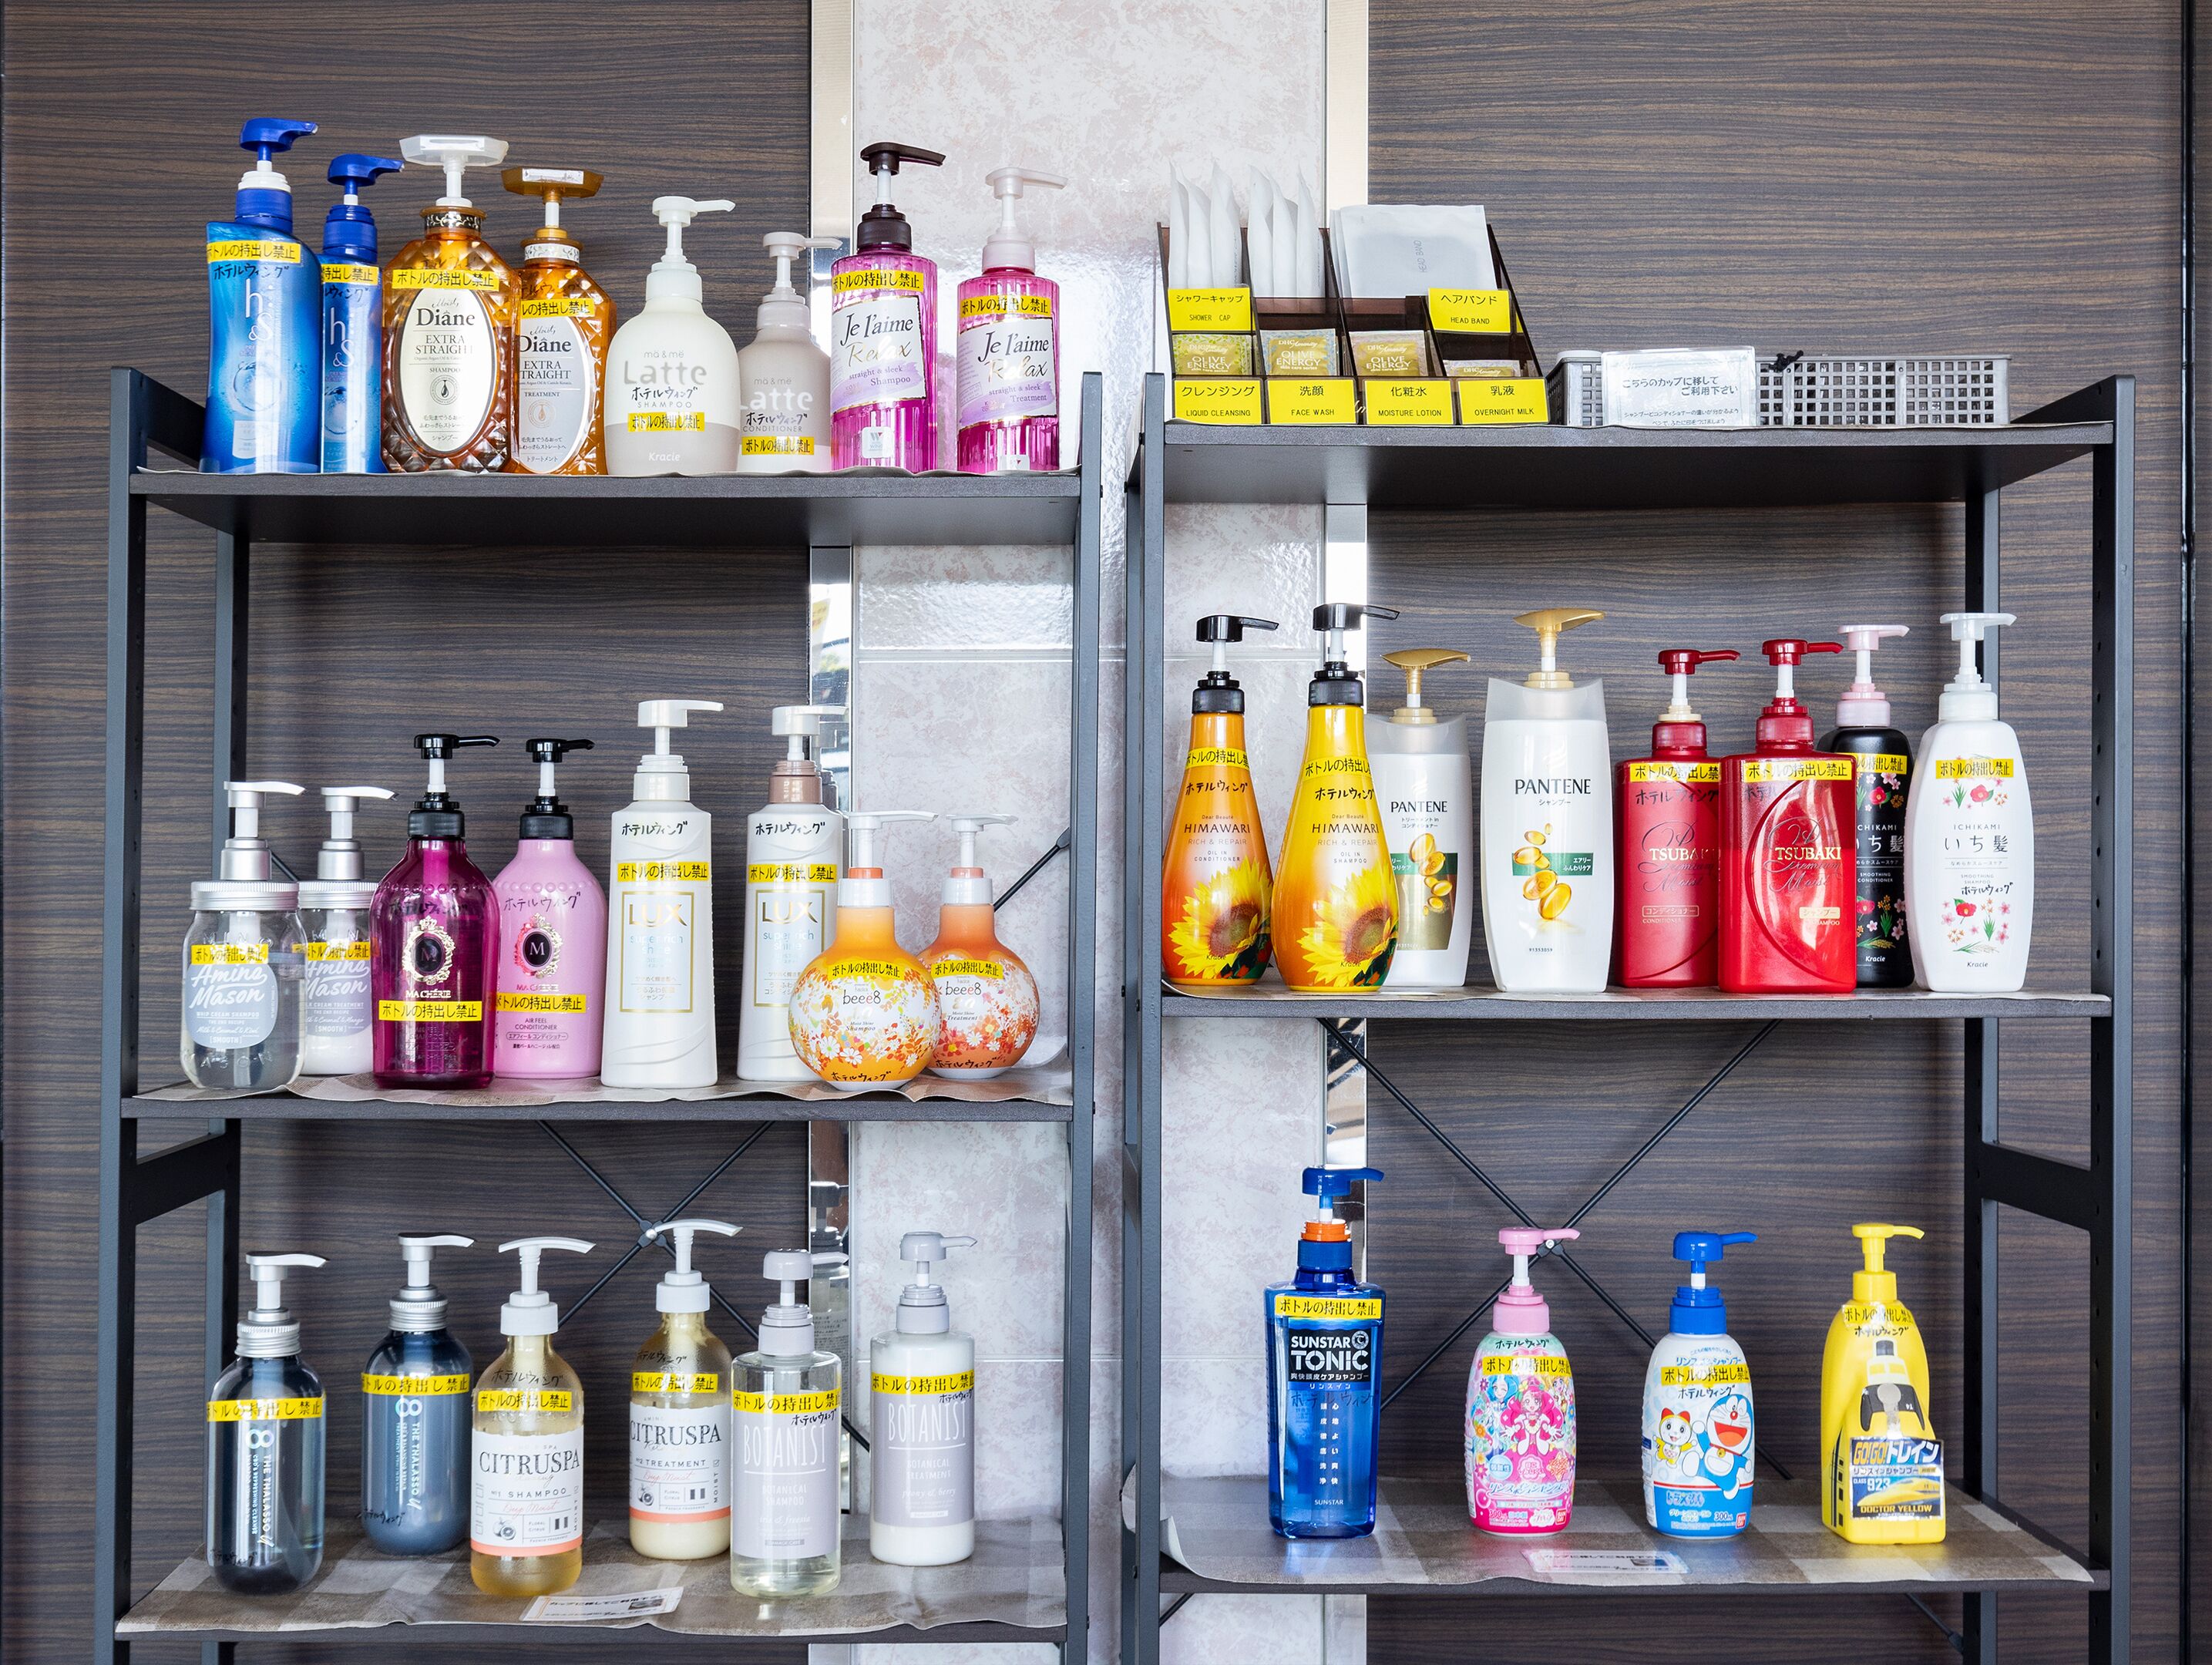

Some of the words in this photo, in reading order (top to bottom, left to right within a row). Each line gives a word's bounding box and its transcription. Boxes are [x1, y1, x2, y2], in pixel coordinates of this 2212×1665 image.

[397, 272, 495, 288] ボトルの持出し禁止
[833, 273, 920, 292] ボトルの持出し禁止
[962, 297, 1049, 314] ボトルの持出し禁止
[1176, 294, 1244, 304] シャワーキャップ
[1440, 294, 1498, 306] ヘアバンド
[840, 312, 861, 347] Je
[425, 335, 465, 344] EXTRA
[977, 331, 1001, 363] Je
[1280, 351, 1316, 359] OLIVE
[524, 361, 562, 369] EXTRA
[624, 360, 708, 385] Latte
[520, 370, 572, 379] TRAIGHT
[870, 375, 912, 386] Shampoo
[1622, 375, 1720, 388] こちらのカップに移して
[1182, 386, 1255, 397] クレンジング
[1299, 386, 1324, 396] 洗顔
[1390, 387, 1427, 397] 化粧水
[1491, 386, 1515, 396] 乳液
[1681, 385, 1739, 396] ご利用下さい
[1010, 394, 1047, 403] Treatment
[632, 412, 701, 430] ボトルの持出し禁止
[745, 438, 811, 454] ボトルの持出し禁止
[648, 452, 681, 462] Kracie
[1635, 765, 1719, 780] ボトルの持出し禁
[1748, 762, 1847, 779] ボトルの持出し禁止
[1940, 763, 2010, 777] ボトルの持出し禁止
[1185, 780, 1248, 796] ホテルウィング
[1514, 779, 1592, 796] PANTENE
[1390, 801, 1448, 813] PANTENE
[621, 821, 688, 837] ホテルウィング
[755, 821, 826, 836] ホテルウィング
[1184, 823, 1251, 834] HIMAWARI
[1312, 823, 1380, 834] HIMAWARI
[1944, 834, 2009, 853] いち髪
[1775, 846, 1841, 861] TSUBAKI
[620, 863, 708, 880] ボトルの持出し禁止
[750, 865, 835, 881] ボトルの持出し禁止
[1960, 882, 2014, 896] ホテルウィング
[503, 892, 581, 913] ホテルウィング
[629, 903, 687, 928] LUX
[762, 900, 819, 925] LUX
[1645, 907, 1697, 916] コンディショナー
[1865, 955, 1886, 964] Kracie
[191, 963, 268, 987] Amino
[832, 961, 901, 979] ボトルの持出し禁止
[934, 961, 1000, 977] ボトルの持出し禁止
[189, 984, 265, 1009] Mason
[382, 1004, 477, 1018] ボトルの持出し禁止
[935, 1056, 998, 1069] ホテルウィング
[831, 1071, 893, 1082] ホテルウィング
[1279, 1300, 1377, 1317] ボトルの持出し禁止
[1291, 1336, 1351, 1349] SUNSTAR
[1494, 1338, 1550, 1349] ホテルウィング
[1290, 1350, 1369, 1371] TONIC
[492, 1369, 563, 1387] ホテルウィング
[634, 1375, 714, 1391] ボトルの持出し禁止
[1678, 1384, 1736, 1399] ホテルウィング
[480, 1394, 569, 1409] ボトルの持出し禁止
[888, 1401, 966, 1442] BOTANIST
[411, 1421, 420, 1441] THE
[630, 1421, 722, 1446] CITRUSPA
[744, 1424, 827, 1468] BOTANIST
[411, 1443, 420, 1495] THALASSO
[479, 1448, 580, 1475] CITRUSPA
[646, 1459, 706, 1468] TREATMENT
[907, 1458, 950, 1468] BOTANICAL
[907, 1469, 952, 1480] TREATMENT
[1854, 1467, 1919, 1475] リンスインシャンプー
[508, 1487, 566, 1498] SHAMPOO
[1867, 1478, 1891, 1492] 923
[262, 1477, 272, 1532] THALASSO
